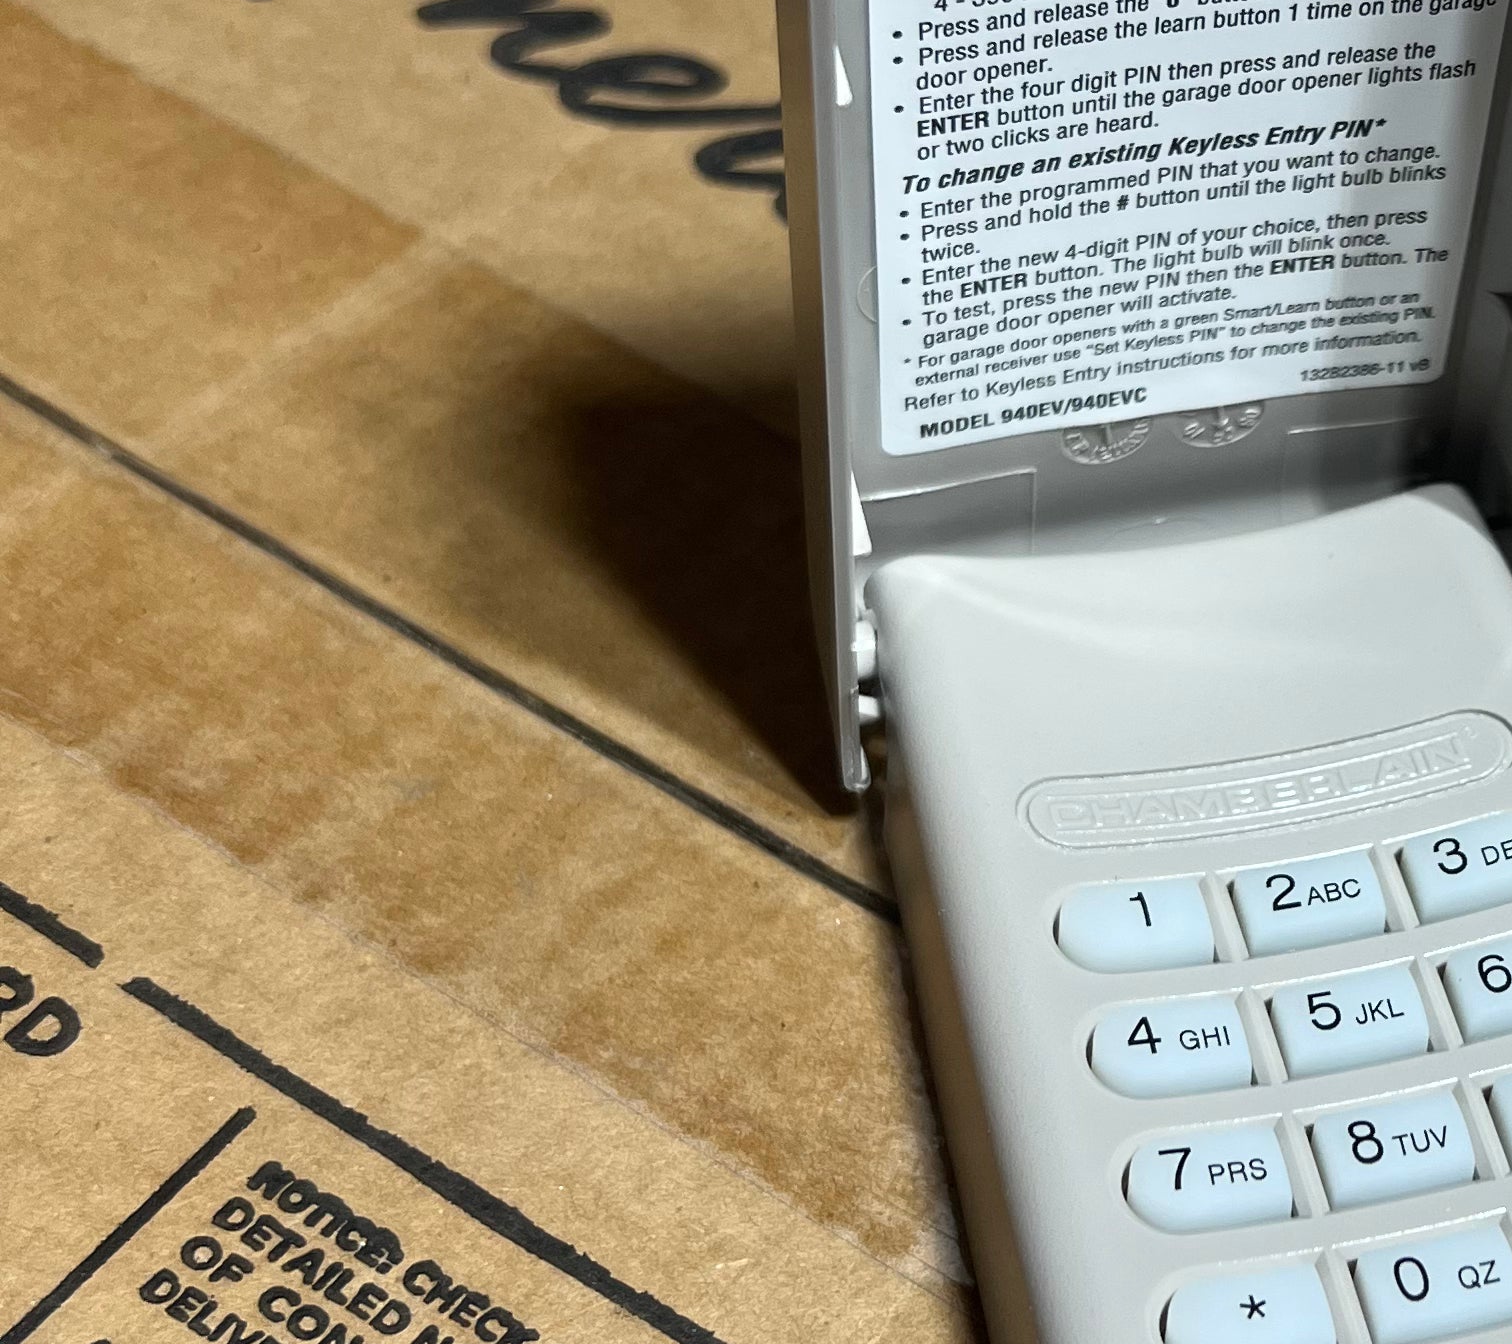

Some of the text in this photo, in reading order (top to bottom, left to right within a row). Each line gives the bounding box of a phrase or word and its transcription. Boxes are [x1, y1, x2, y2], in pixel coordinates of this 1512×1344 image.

[918, 17, 980, 42] Press
[985, 7, 1026, 32] and
[1033, 0, 1109, 26] release
[916, 112, 1160, 161] or two clicks are heard.
[902, 174, 931, 194] To
[937, 161, 1026, 189] change
[1030, 156, 1062, 175] an
[1067, 142, 1163, 169] existing
[1167, 132, 1261, 158] Keyless
[1264, 124, 1327, 146] Entry
[920, 241, 981, 264] twice.
[922, 286, 1239, 349] garage door opener will activate.
[919, 412, 996, 439] MODEL
[1000, 389, 1148, 424] 940EV/940EVC
[1047, 741, 1470, 829] CHAMBERLAIN
[1434, 838, 1467, 874] 3
[1130, 892, 1151, 926] 1
[1266, 874, 1360, 911] 2 ABC
[1478, 955, 1511, 992] 6
[1307, 991, 1404, 1030] 5 JKL
[1128, 1017, 1229, 1053] 4 GHI
[1348, 1121, 1446, 1164] 8 TUV
[1159, 1148, 1267, 1190] 7 PRS
[179, 1235, 255, 1283] OF
[210, 1196, 412, 1336] DETAILED
[1394, 1258, 1500, 1301] 0 QZ
